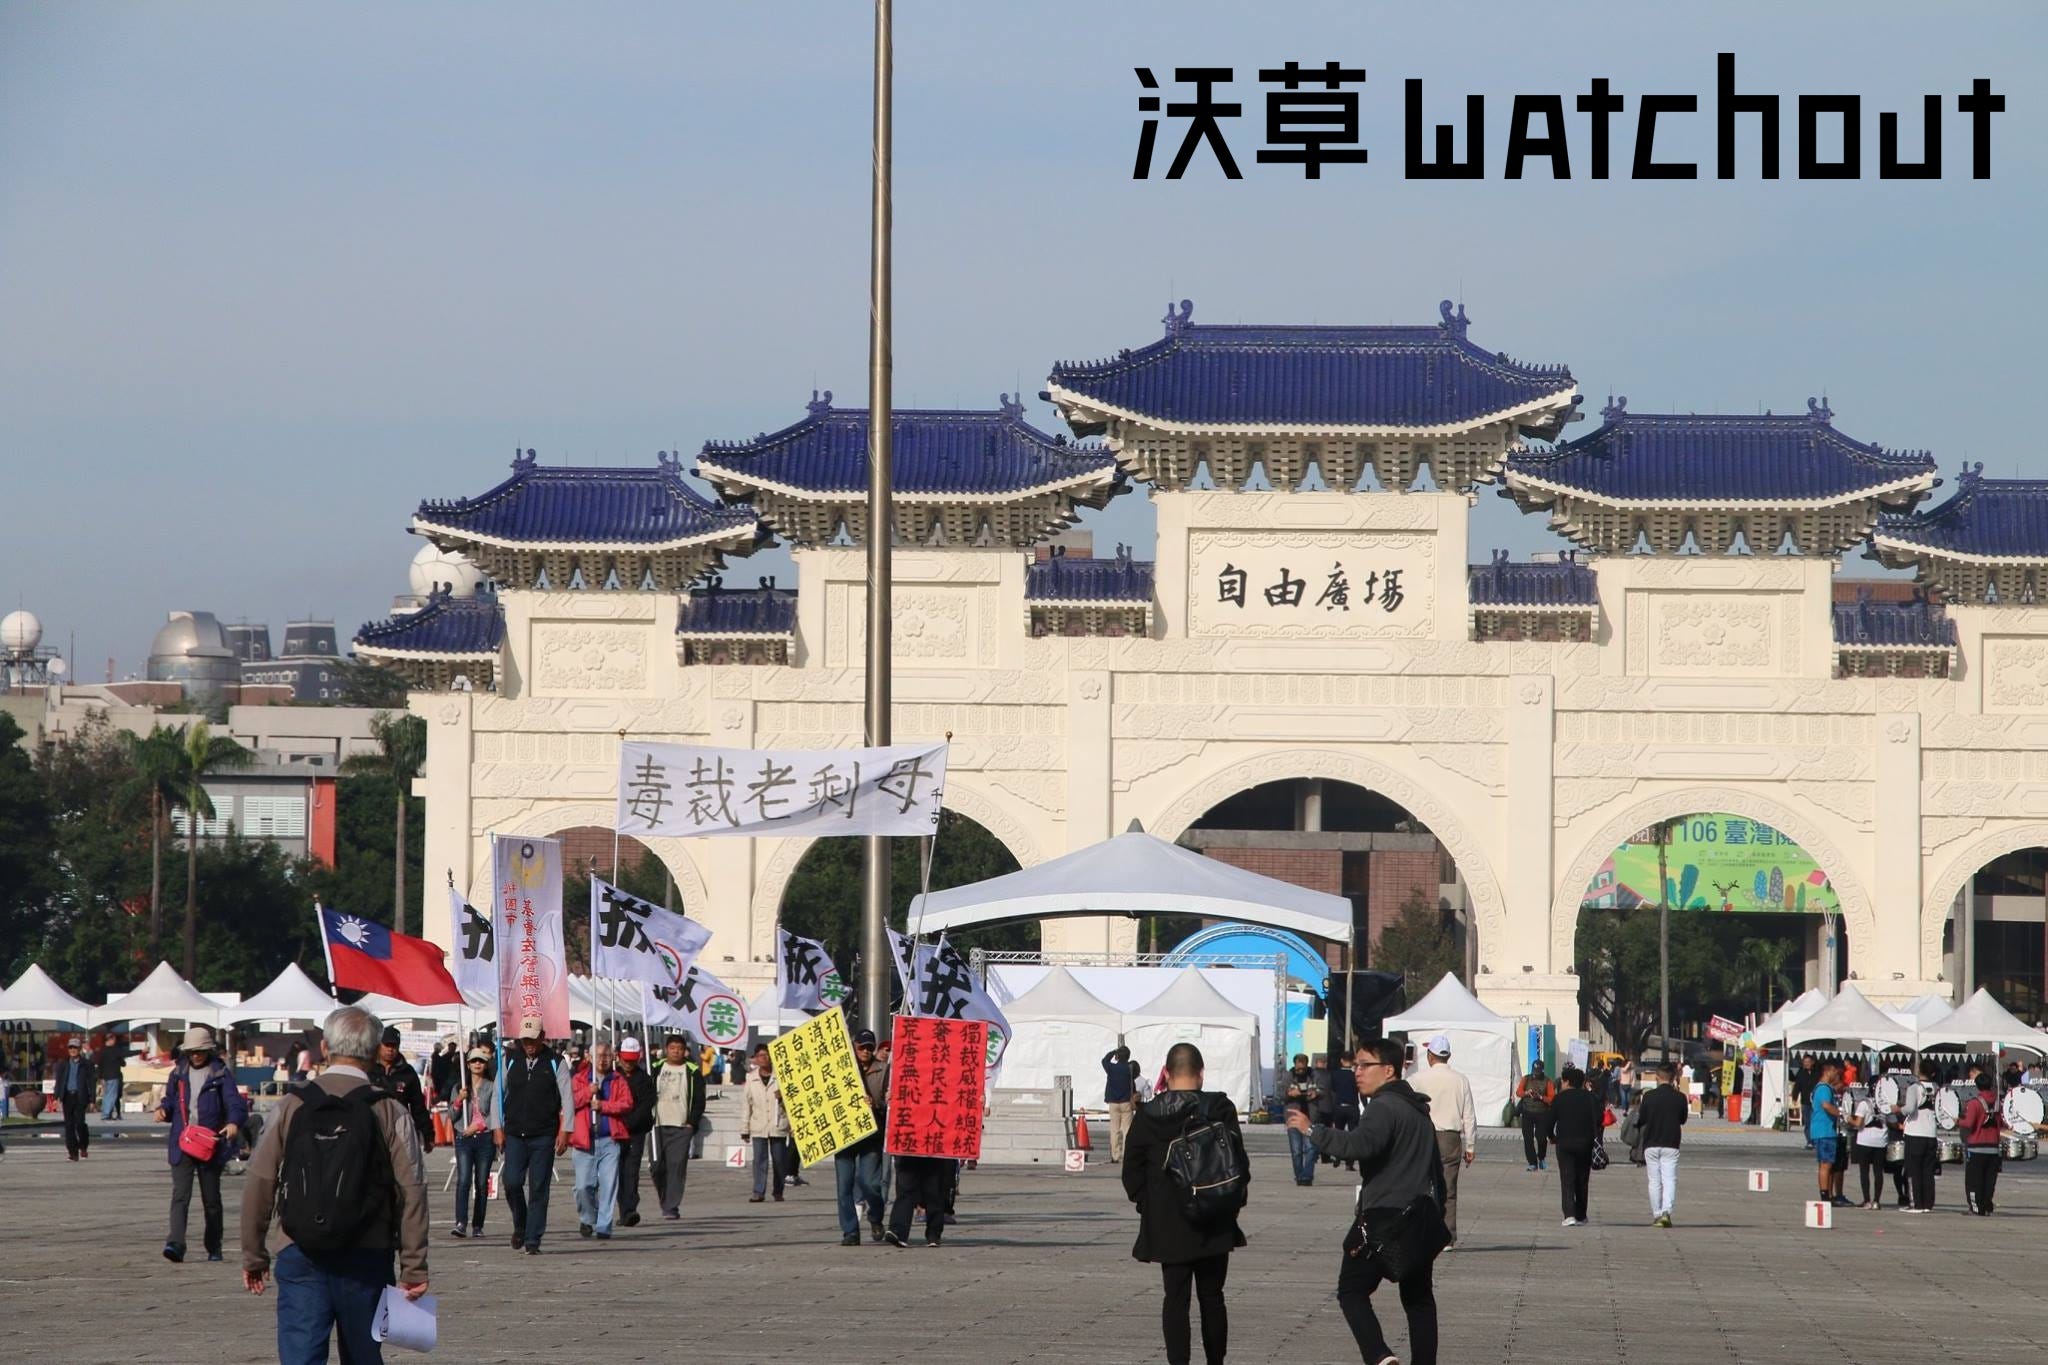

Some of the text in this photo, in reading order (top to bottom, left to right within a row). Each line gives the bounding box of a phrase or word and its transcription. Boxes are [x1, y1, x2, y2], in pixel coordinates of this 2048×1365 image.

[627, 753, 933, 829] 毒裁老剩母
[1681, 820, 1718, 842] 106
[706, 1002, 739, 1036] 菜
[923, 1021, 952, 1154] 奢談民主人權
[953, 1023, 982, 1155] 獨裁威權總統
[729, 1147, 744, 1166] 4
[1066, 1151, 1083, 1170] 3
[1755, 1172, 1763, 1190] 1
[1814, 1203, 1824, 1227] 1
